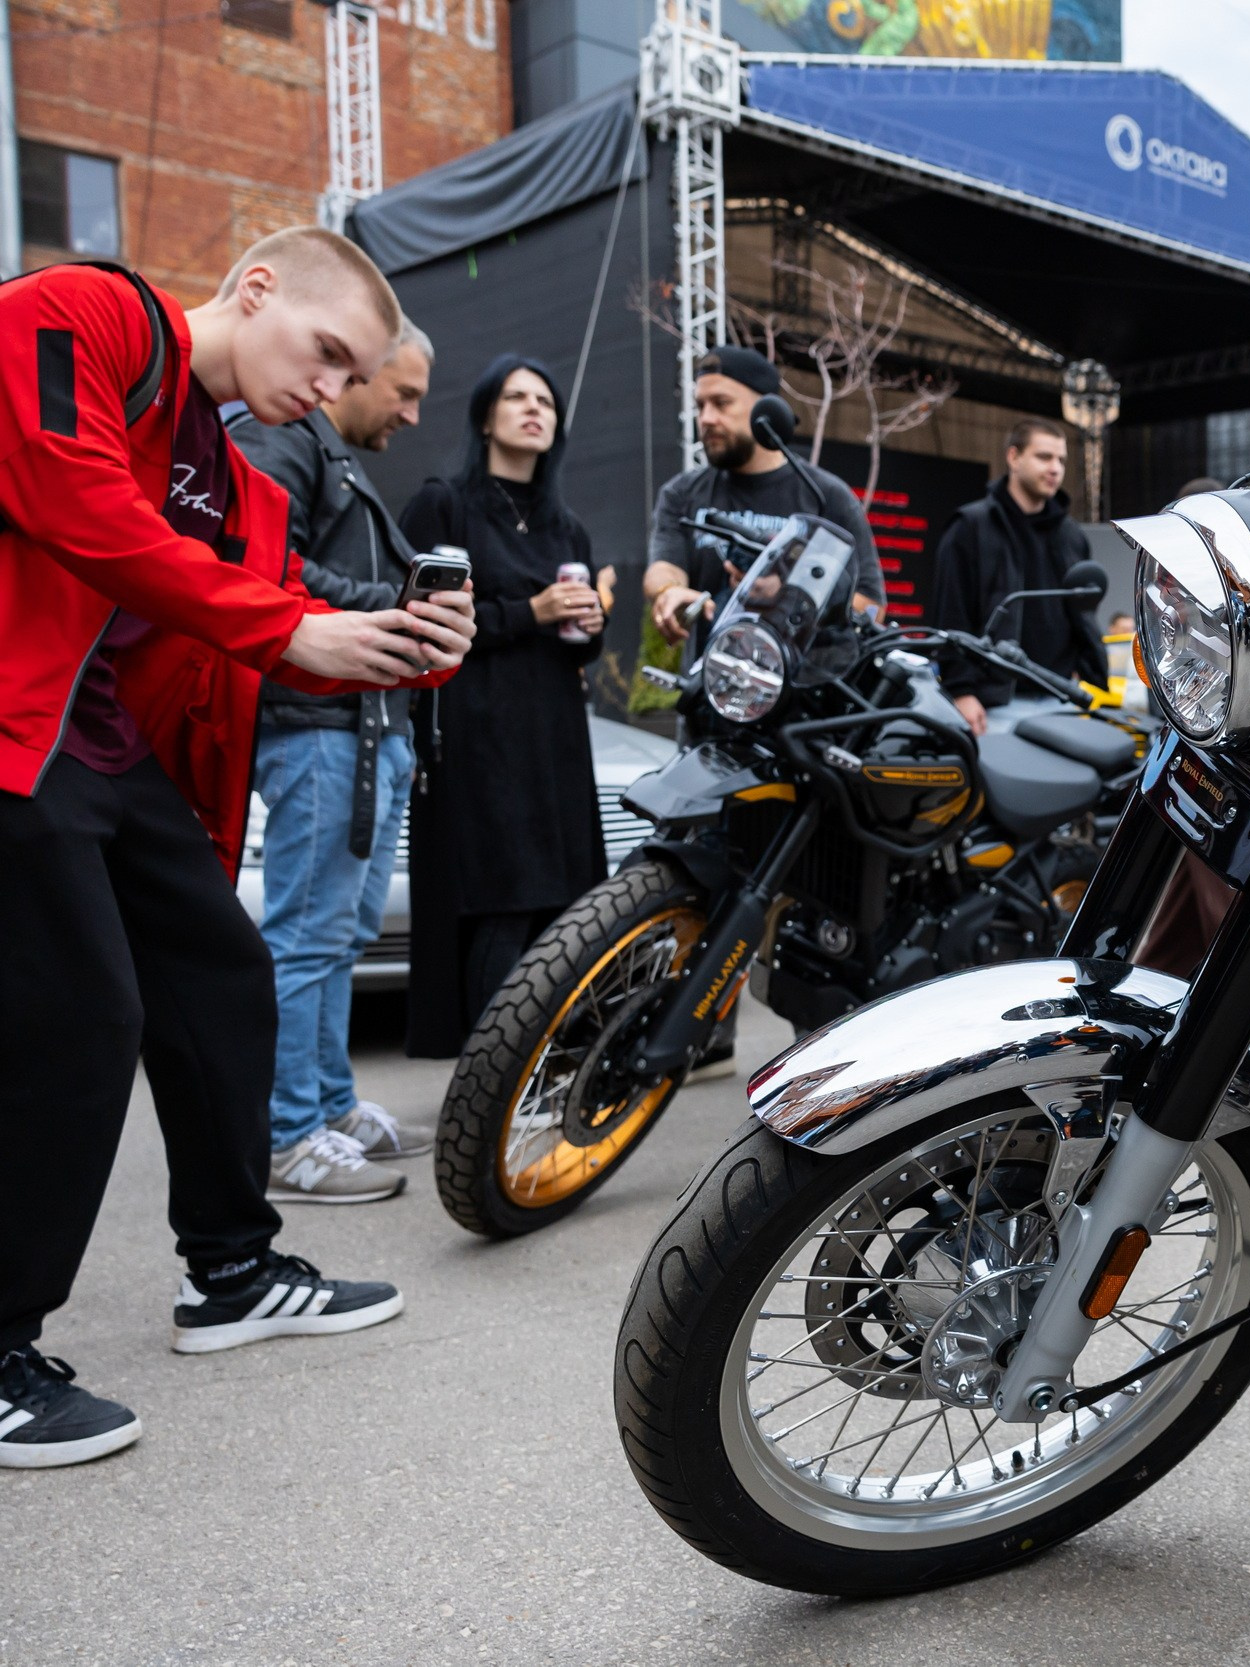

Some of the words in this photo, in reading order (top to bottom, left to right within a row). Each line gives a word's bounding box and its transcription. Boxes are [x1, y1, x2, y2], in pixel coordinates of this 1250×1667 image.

[1182, 759, 1200, 781] ROYAL
[1198, 774, 1224, 802] ENFIELD
[692, 939, 748, 1020] HIMALAYAN
[284, 1157, 332, 1191] N
